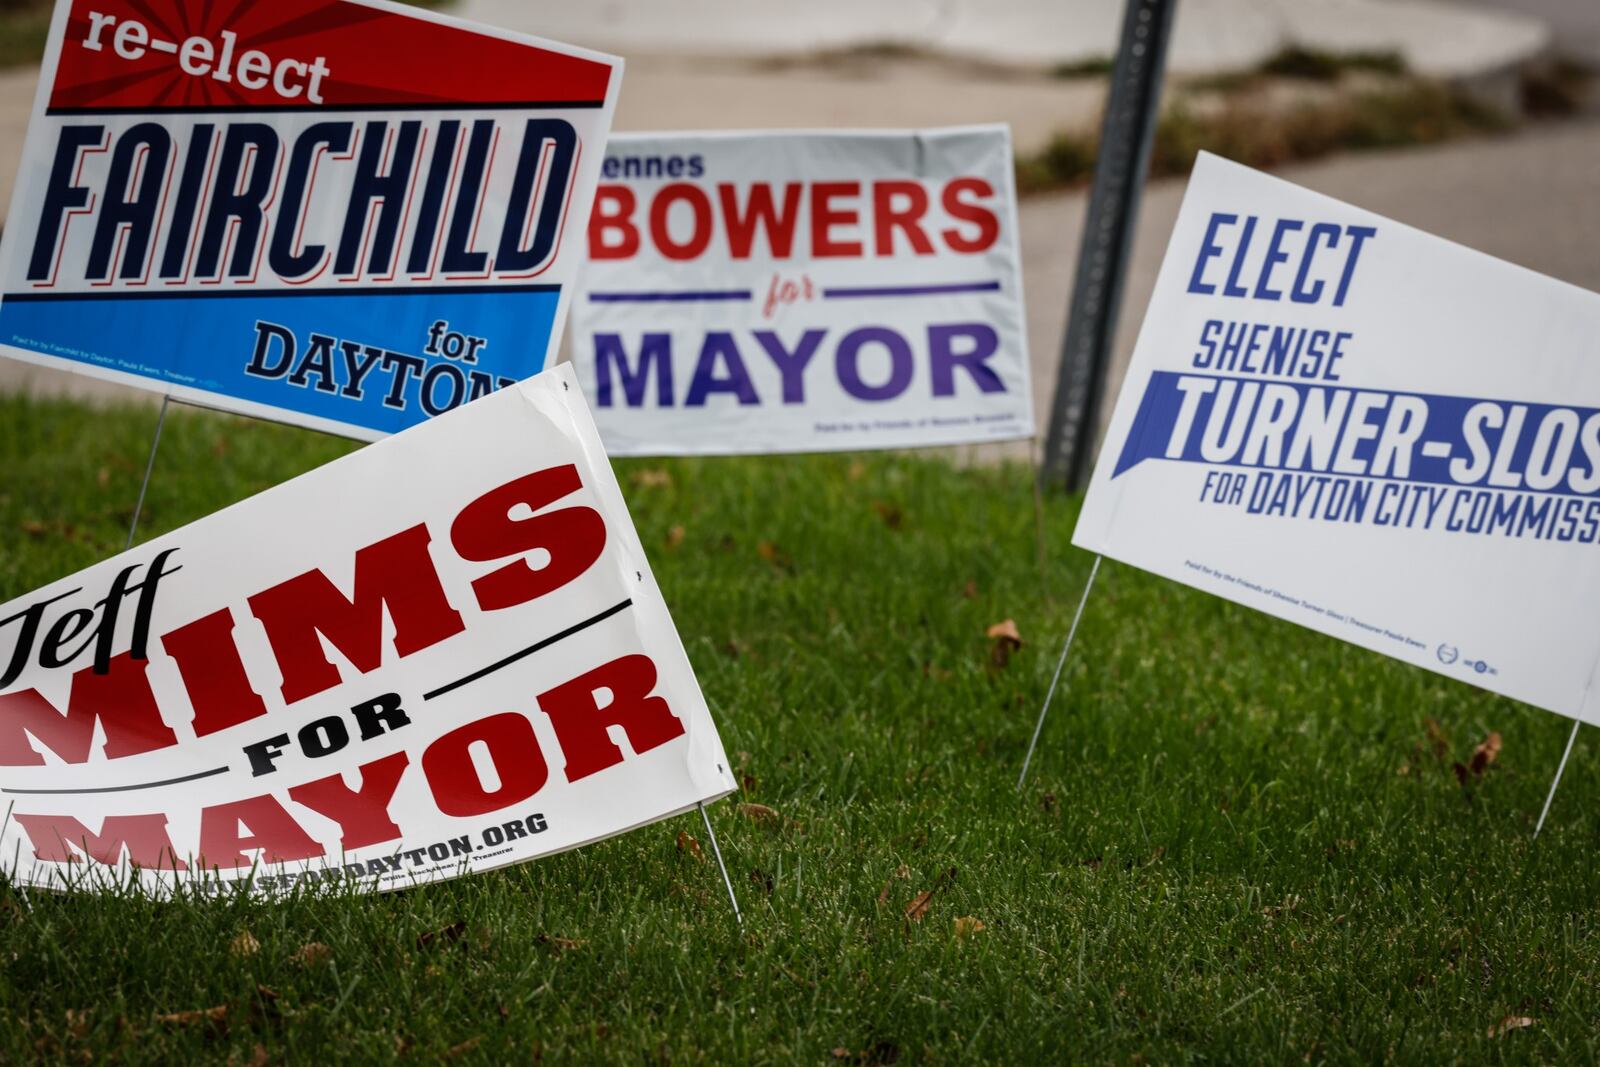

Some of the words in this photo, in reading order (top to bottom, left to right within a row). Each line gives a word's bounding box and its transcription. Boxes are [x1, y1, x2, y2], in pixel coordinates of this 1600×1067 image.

[82, 11, 330, 104] re-elect
[27, 118, 581, 286] FAIRCHILD
[601, 154, 706, 179] ennes
[587, 177, 1001, 261] BOWERS
[1187, 213, 1378, 308] ELECT
[761, 272, 816, 318] for
[424, 319, 487, 365] for
[592, 321, 1008, 409] MAYOR
[1192, 319, 1353, 381] SHENISE
[1200, 470, 1250, 506] FOR
[1246, 471, 1374, 524] DAYTON
[1372, 483, 1448, 530] CITY
[1445, 489, 1600, 545] COMMISS
[0, 463, 607, 767] MIMS
[0, 547, 184, 691] Jeff
[12, 652, 685, 871] MAYOR
[242, 691, 412, 778] FOR
